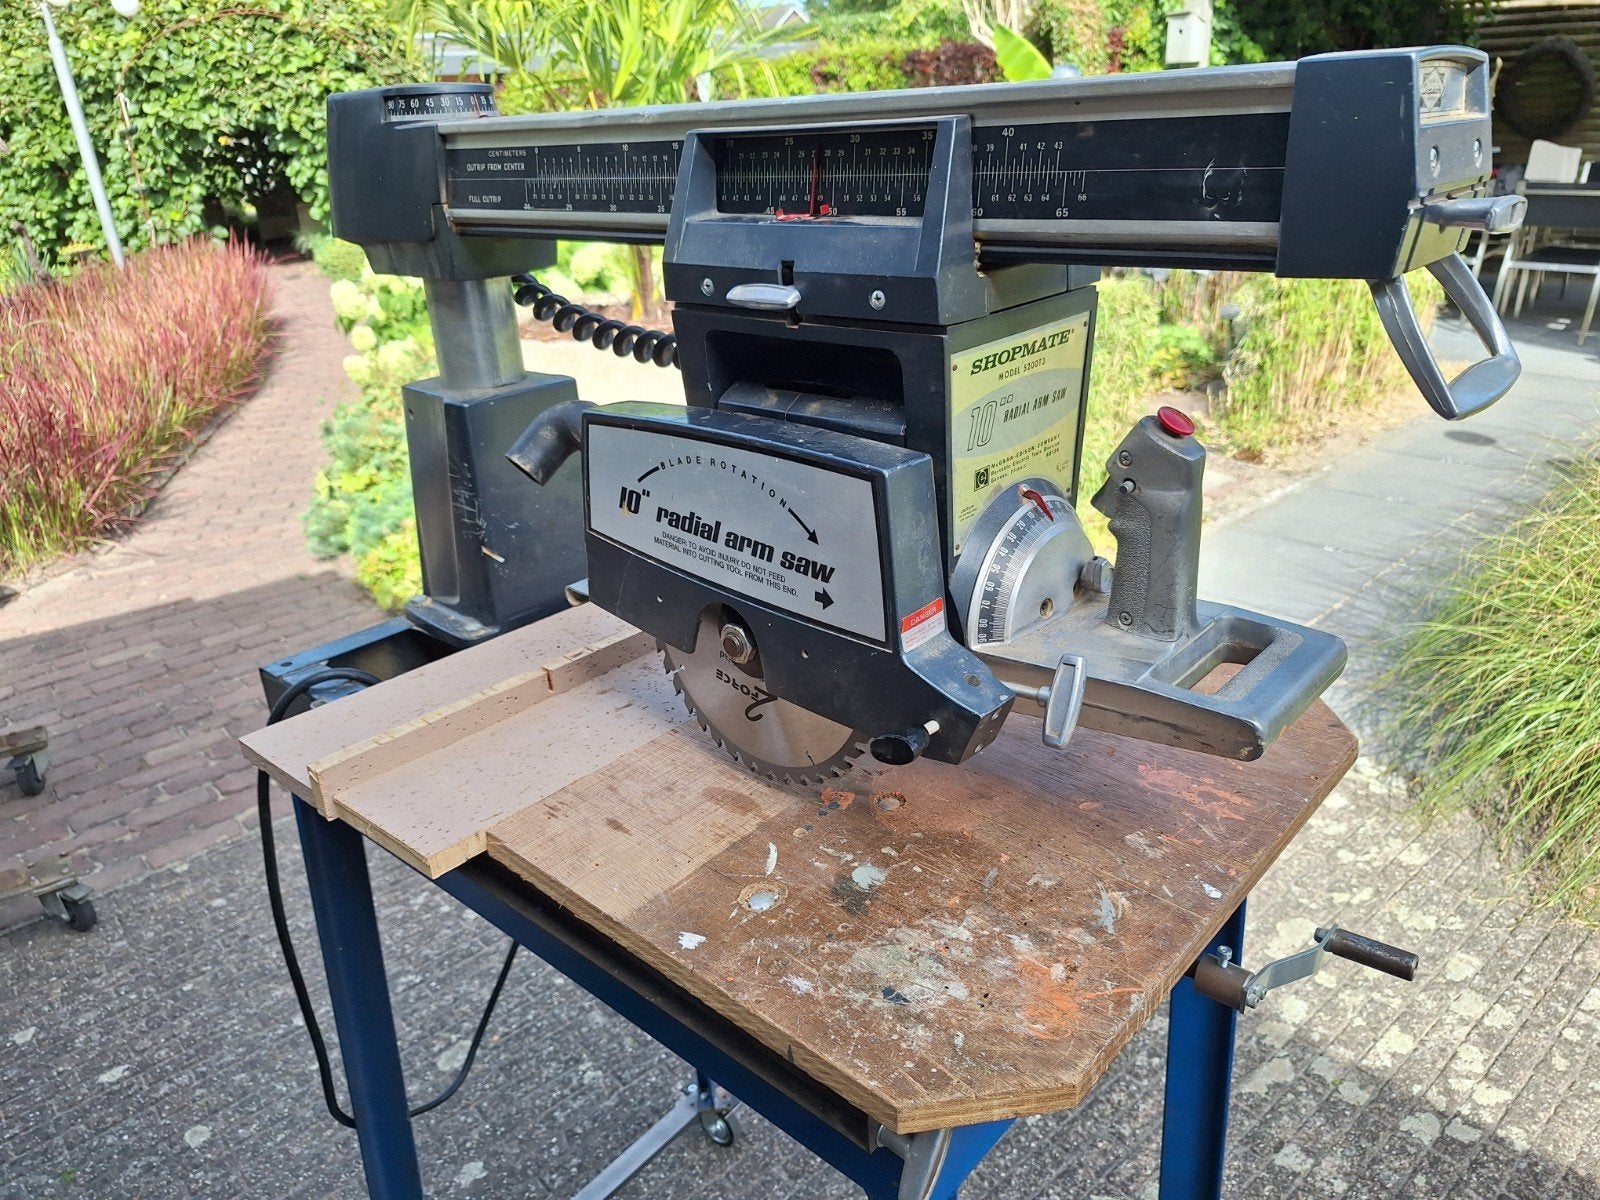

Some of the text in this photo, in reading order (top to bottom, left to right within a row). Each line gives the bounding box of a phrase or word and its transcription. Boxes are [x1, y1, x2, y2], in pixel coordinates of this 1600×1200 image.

[398, 100, 406, 108] 75
[410, 98, 420, 108] 60
[425, 98, 434, 108] 45
[440, 97, 450, 106] 30
[454, 96, 464, 106] 15
[784, 136, 794, 146] 25
[850, 134, 860, 143] 30
[922, 131, 933, 140] 35
[1002, 128, 1015, 137] 40
[1020, 142, 1063, 151] 41 42 43
[488, 150, 526, 158] CENTIMETERS
[504, 163, 525, 171] CENTER
[482, 195, 502, 203] OUTRIP
[991, 194, 999, 202] 61
[1008, 194, 1016, 202] 62
[1024, 194, 1032, 202] 63
[1041, 194, 1050, 202] 64
[1078, 194, 1087, 202] 66
[657, 204, 665, 213] 35
[896, 207, 906, 216] 55
[971, 208, 983, 217] 60
[1056, 208, 1068, 217] 65
[970, 329, 1070, 376] SHOPMATE
[998, 366, 1020, 381] MODEL
[1003, 401, 1030, 423] RADIAL
[1032, 394, 1049, 412] ARM
[1052, 387, 1068, 403] SAW
[1037, 434, 1060, 449] COMPANY
[659, 455, 788, 508] BLADE ROTATION
[1016, 520, 1026, 530] 20
[618, 486, 836, 584] 10" radial arm saw
[1006, 532, 1017, 543] 30
[999, 546, 1008, 557] 40
[653, 536, 798, 598] MATERIAL INTO CUTTING TOOL FROM THIS END.
[688, 540, 697, 550] TO
[698, 544, 716, 557] AVOID
[740, 560, 751, 569] DO
[752, 565, 766, 576] NOT
[768, 570, 786, 583] FEED
[991, 564, 1001, 574] 50
[985, 581, 995, 592] 60
[981, 600, 990, 609] 70
[910, 606, 937, 626] DANGER
[979, 618, 988, 628] 80
[978, 634, 987, 643] 90
